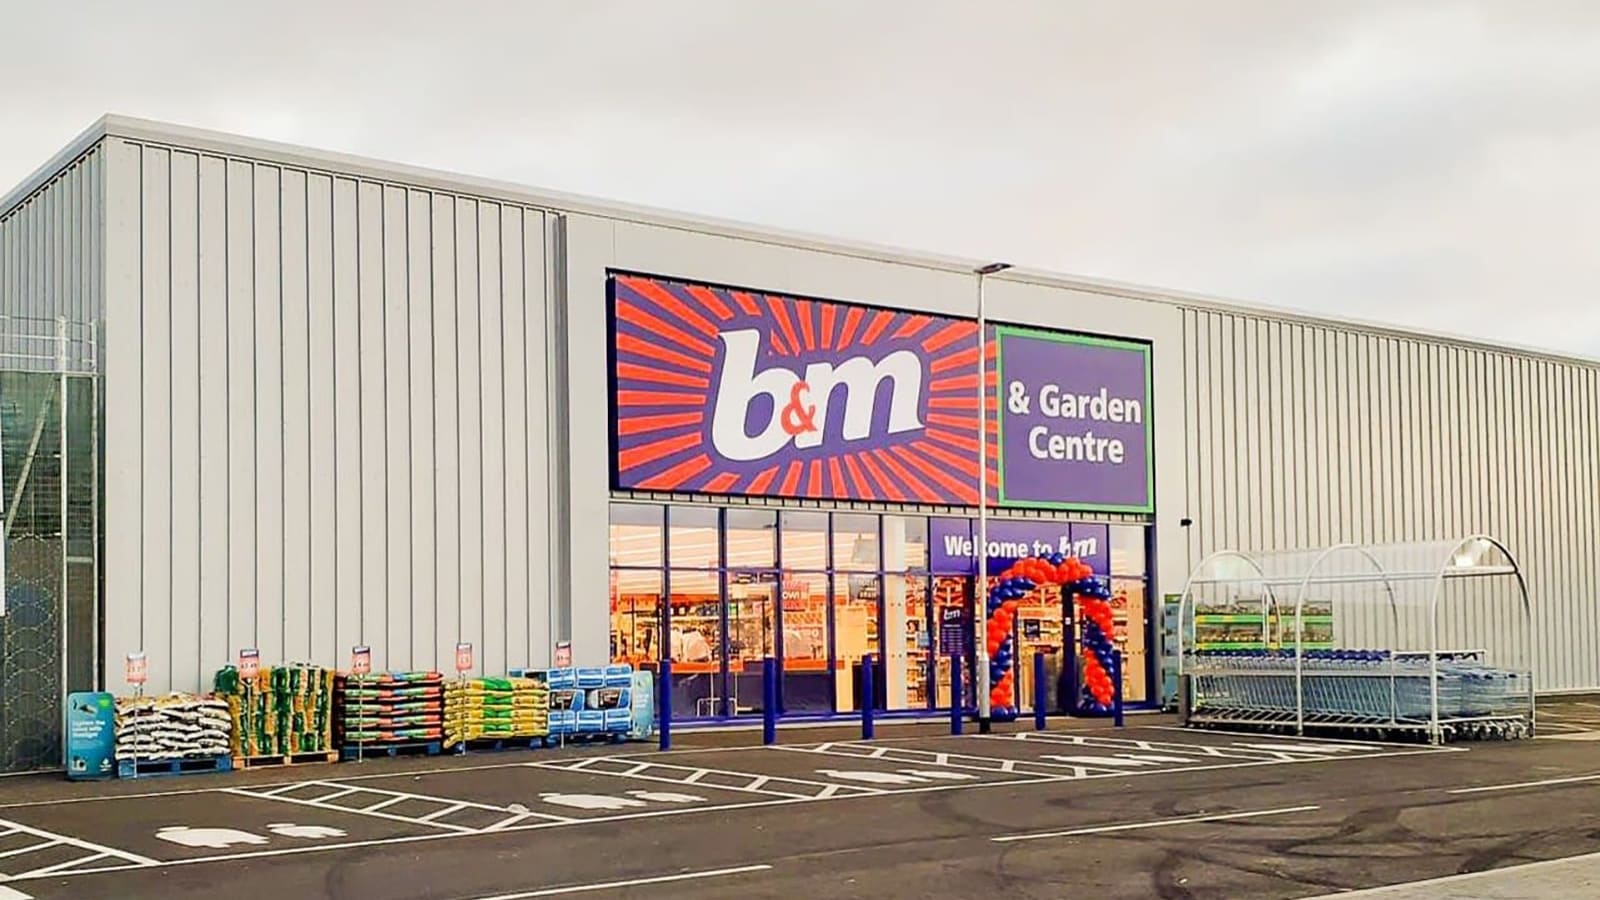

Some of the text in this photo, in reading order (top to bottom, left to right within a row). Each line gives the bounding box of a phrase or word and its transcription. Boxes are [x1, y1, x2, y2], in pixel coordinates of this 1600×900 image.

[1008, 380, 1142, 424] & Garden
[1028, 425, 1124, 464] Centre
[1032, 539, 1053, 558] to
